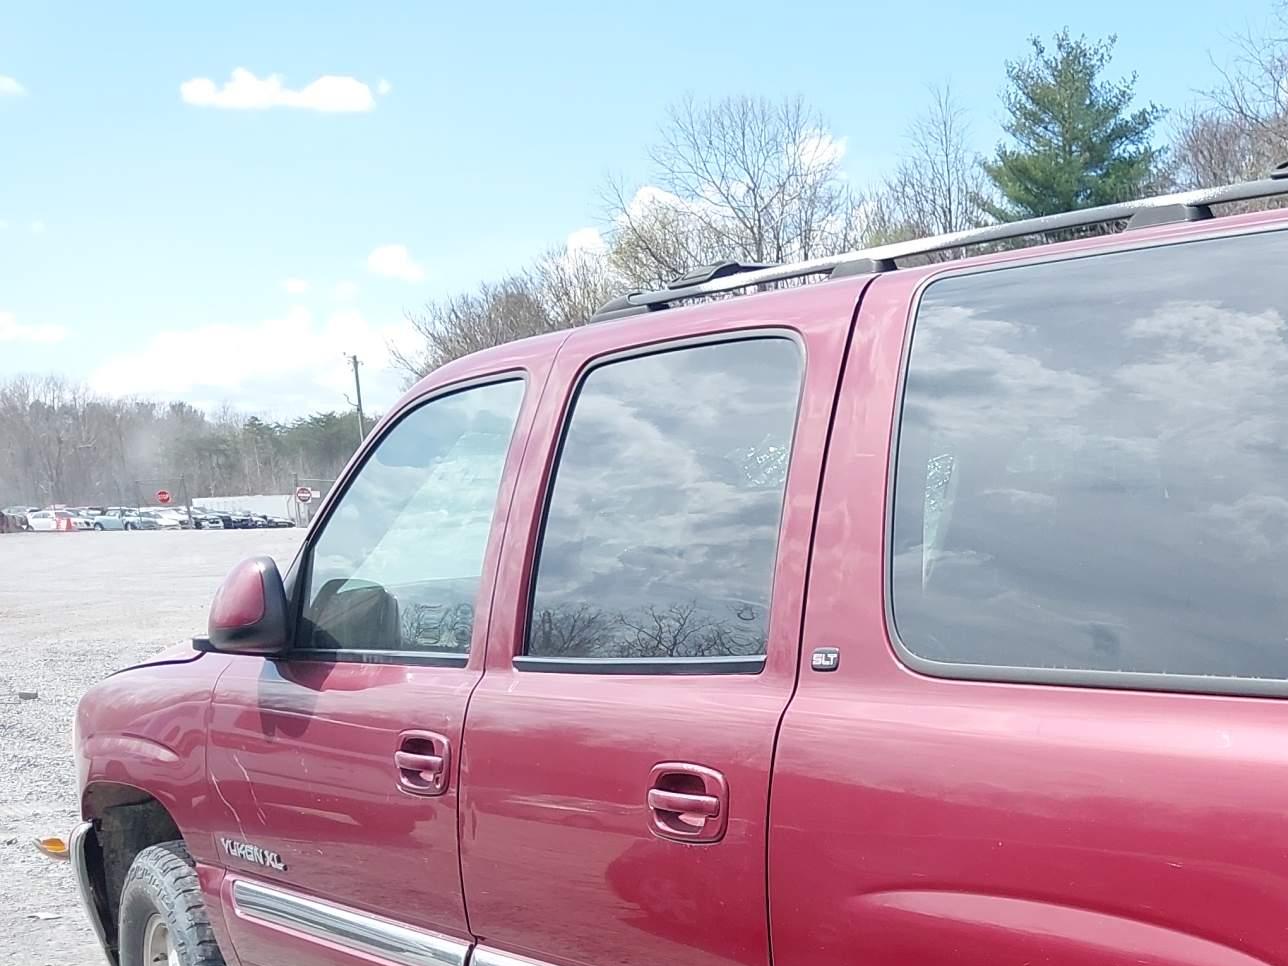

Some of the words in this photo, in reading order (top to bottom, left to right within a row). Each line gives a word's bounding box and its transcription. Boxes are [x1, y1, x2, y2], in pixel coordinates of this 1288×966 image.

[812, 653, 837, 666] SLT
[220, 837, 265, 865] YUKON
[264, 848, 286, 871] XL
